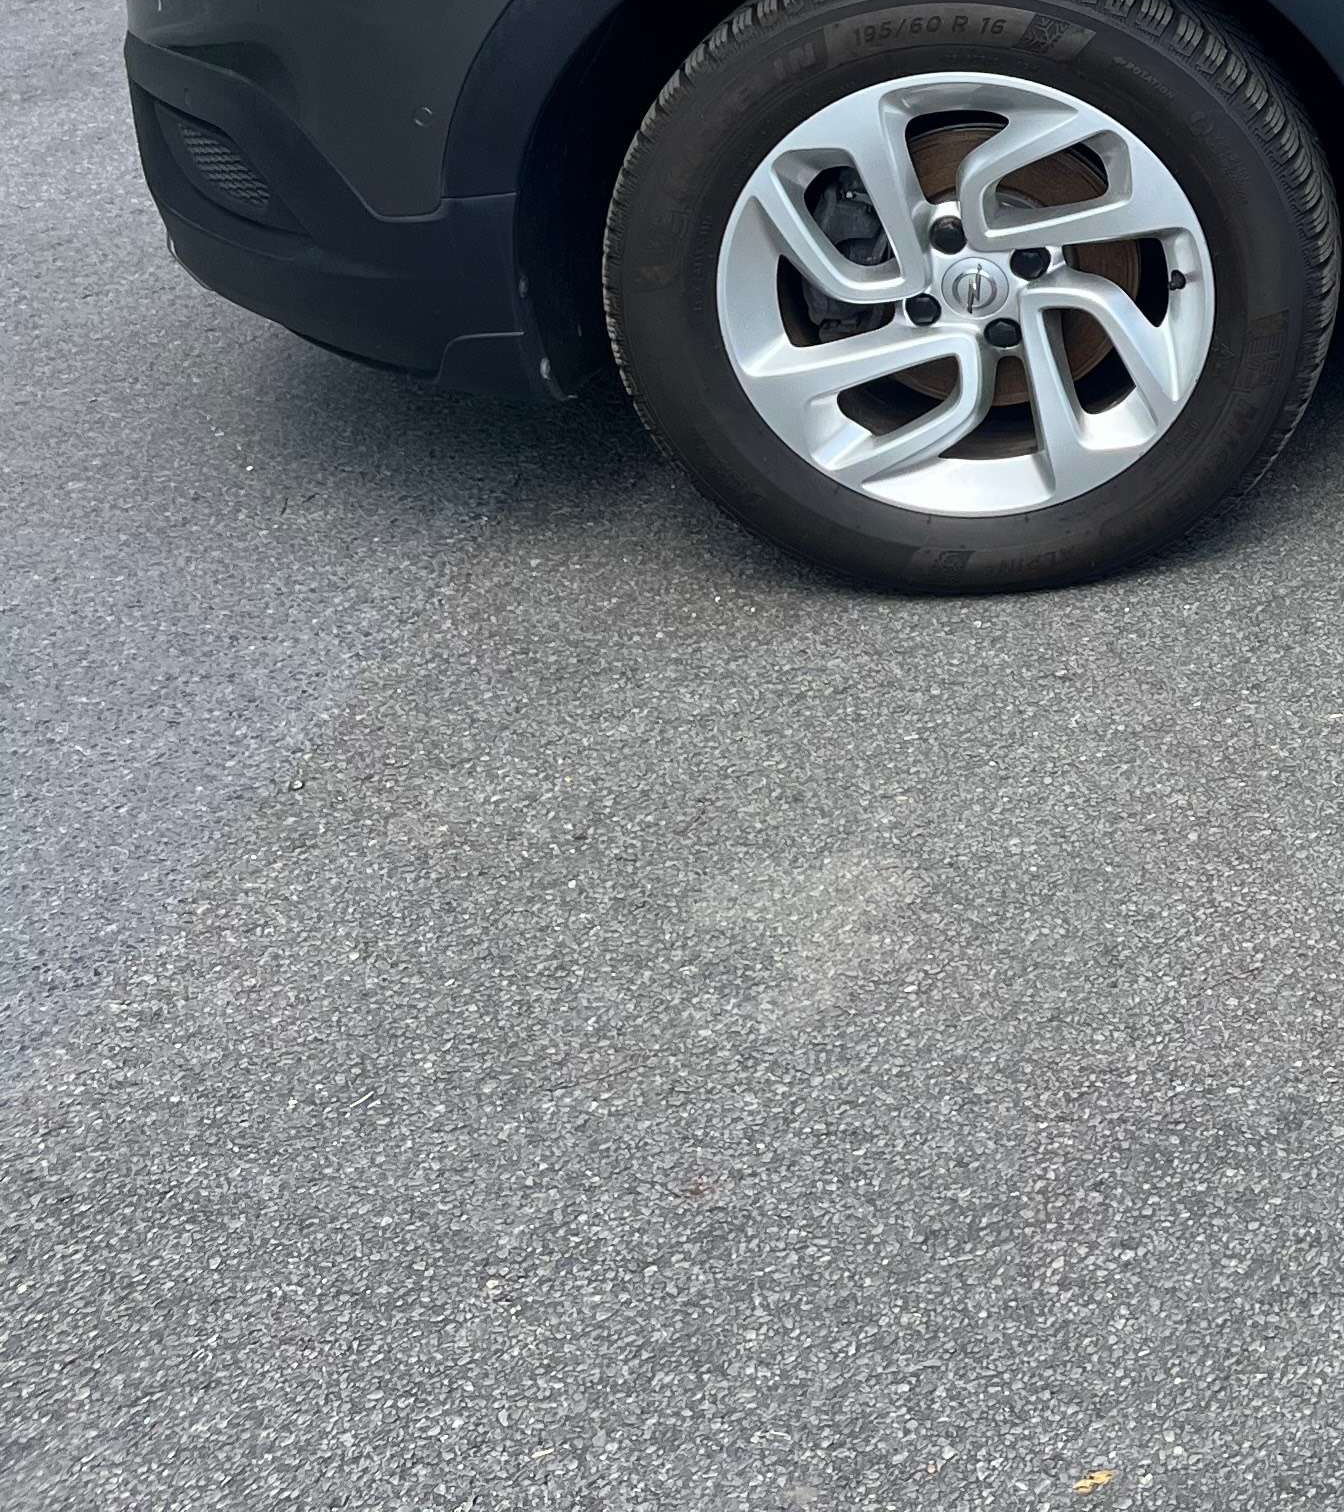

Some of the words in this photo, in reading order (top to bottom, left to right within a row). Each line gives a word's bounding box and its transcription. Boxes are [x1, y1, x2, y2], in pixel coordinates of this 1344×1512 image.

[854, 15, 943, 47] 195/60
[952, 15, 970, 33] R
[980, 15, 1007, 35] 16
